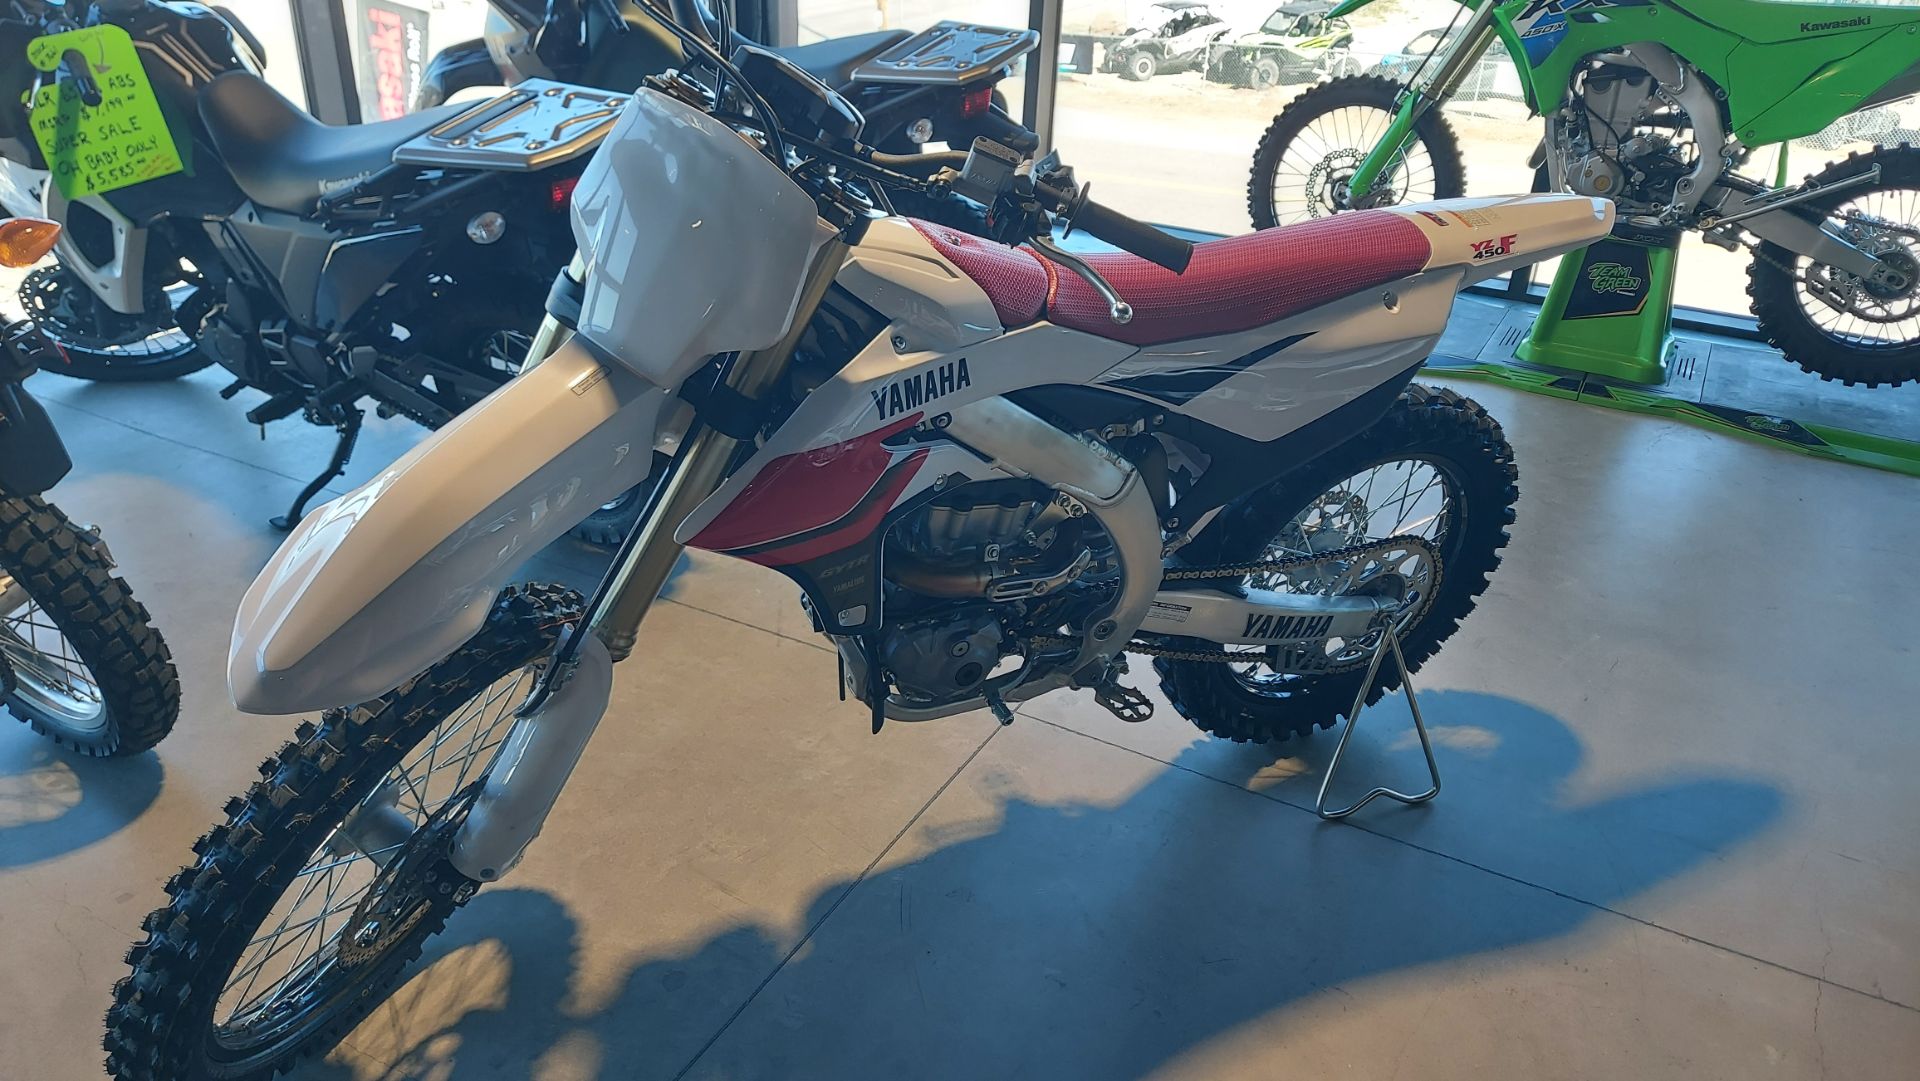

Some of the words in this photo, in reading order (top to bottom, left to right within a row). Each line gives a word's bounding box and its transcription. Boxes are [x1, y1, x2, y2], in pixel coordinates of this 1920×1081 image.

[1800, 15, 1871, 33] Kawasaki
[368, 7, 404, 120] asaki
[31, 90, 56, 110] LR
[107, 73, 136, 90] ABS
[45, 131, 92, 156] SUPER
[99, 115, 142, 141] SALE
[84, 147, 119, 170] BABY
[125, 134, 159, 158] ONLY
[1589, 263, 1631, 279] TEAM
[1592, 277, 1641, 292] GREEN
[870, 357, 971, 421] YAMAHA
[1241, 613, 1335, 639] YAMAHA
